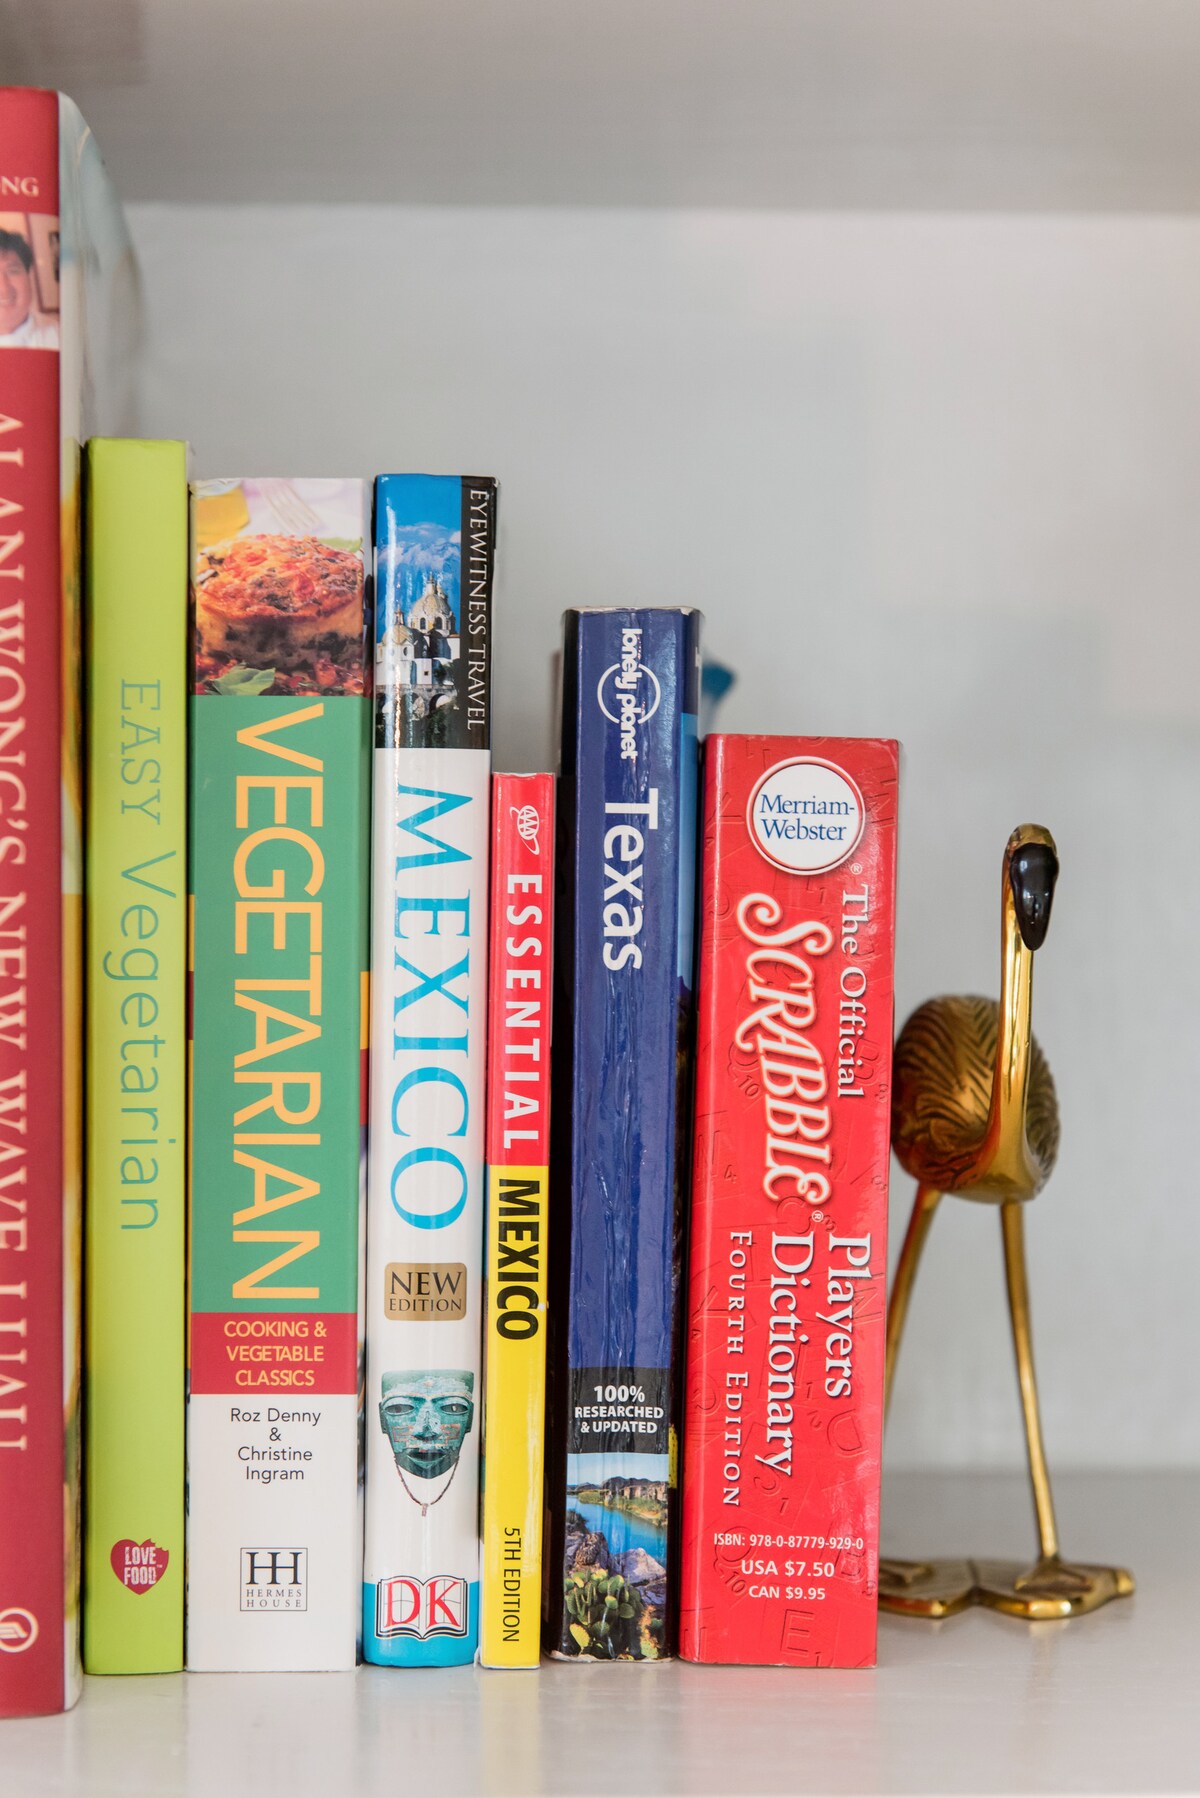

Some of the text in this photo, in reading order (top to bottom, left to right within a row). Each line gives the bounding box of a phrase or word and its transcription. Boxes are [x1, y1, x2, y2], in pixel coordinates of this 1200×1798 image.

[467, 489, 489, 731] EYEWITNESS TRAVEL
[614, 627, 643, 760] lonely planet
[759, 793, 855, 816] Merriam-
[760, 818, 847, 841] Webster
[603, 787, 659, 972] Texas
[103, 679, 178, 1231] EASY Vegetarian
[231, 703, 325, 1300] VEGETARIAN
[837, 884, 870, 1098] The Official
[389, 784, 473, 1231] MEXICO
[503, 874, 544, 1150] ESSENTIAL
[496, 1178, 540, 1341] MEXICO
[388, 1269, 463, 1298] NEW
[388, 1298, 463, 1313] EDITION
[815, 1232, 872, 1398] Players
[223, 1320, 327, 1338] COOKING &
[225, 1345, 325, 1362] VEGETABLE
[754, 1231, 814, 1476] Dictionary
[235, 1369, 316, 1387] CLASSICS
[722, 1230, 753, 1507] FOURTH EDITION
[593, 1385, 646, 1403] 100%
[230, 1407, 322, 1427] Roz Denny
[574, 1406, 665, 1420] RESEARCHED
[269, 1427, 282, 1442] &
[580, 1421, 658, 1434] & UPDATED
[237, 1445, 313, 1461] Christine
[245, 1465, 305, 1485] Ingram
[713, 1532, 864, 1550] ISBN: 978-0-87779-929-0
[124, 1545, 157, 1566] LOVE
[123, 1566, 157, 1586] FOOD
[741, 1560, 835, 1578] USA $7.50
[246, 1588, 302, 1598] HERMES
[501, 1527, 521, 1643] 5TH EDITION
[748, 1585, 826, 1601] CAN $9.95
[246, 1599, 302, 1608] HOUSE
[383, 1577, 459, 1629] DK
